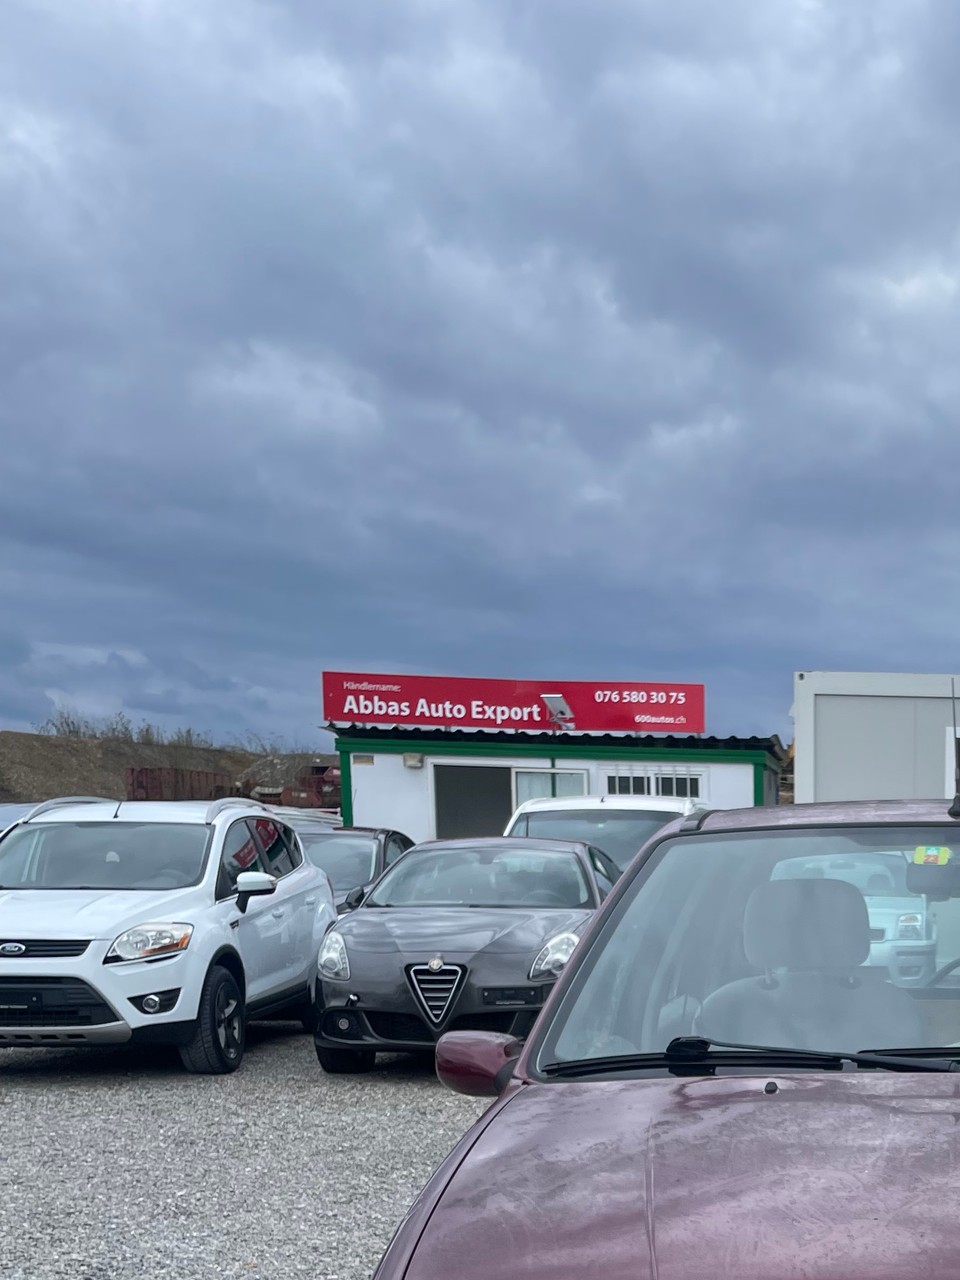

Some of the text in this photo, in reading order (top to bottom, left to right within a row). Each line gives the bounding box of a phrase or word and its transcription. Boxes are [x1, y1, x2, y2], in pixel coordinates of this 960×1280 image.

[594, 690, 686, 704] 076 580 30 75
[343, 694, 541, 724] Abbas Auto Export
